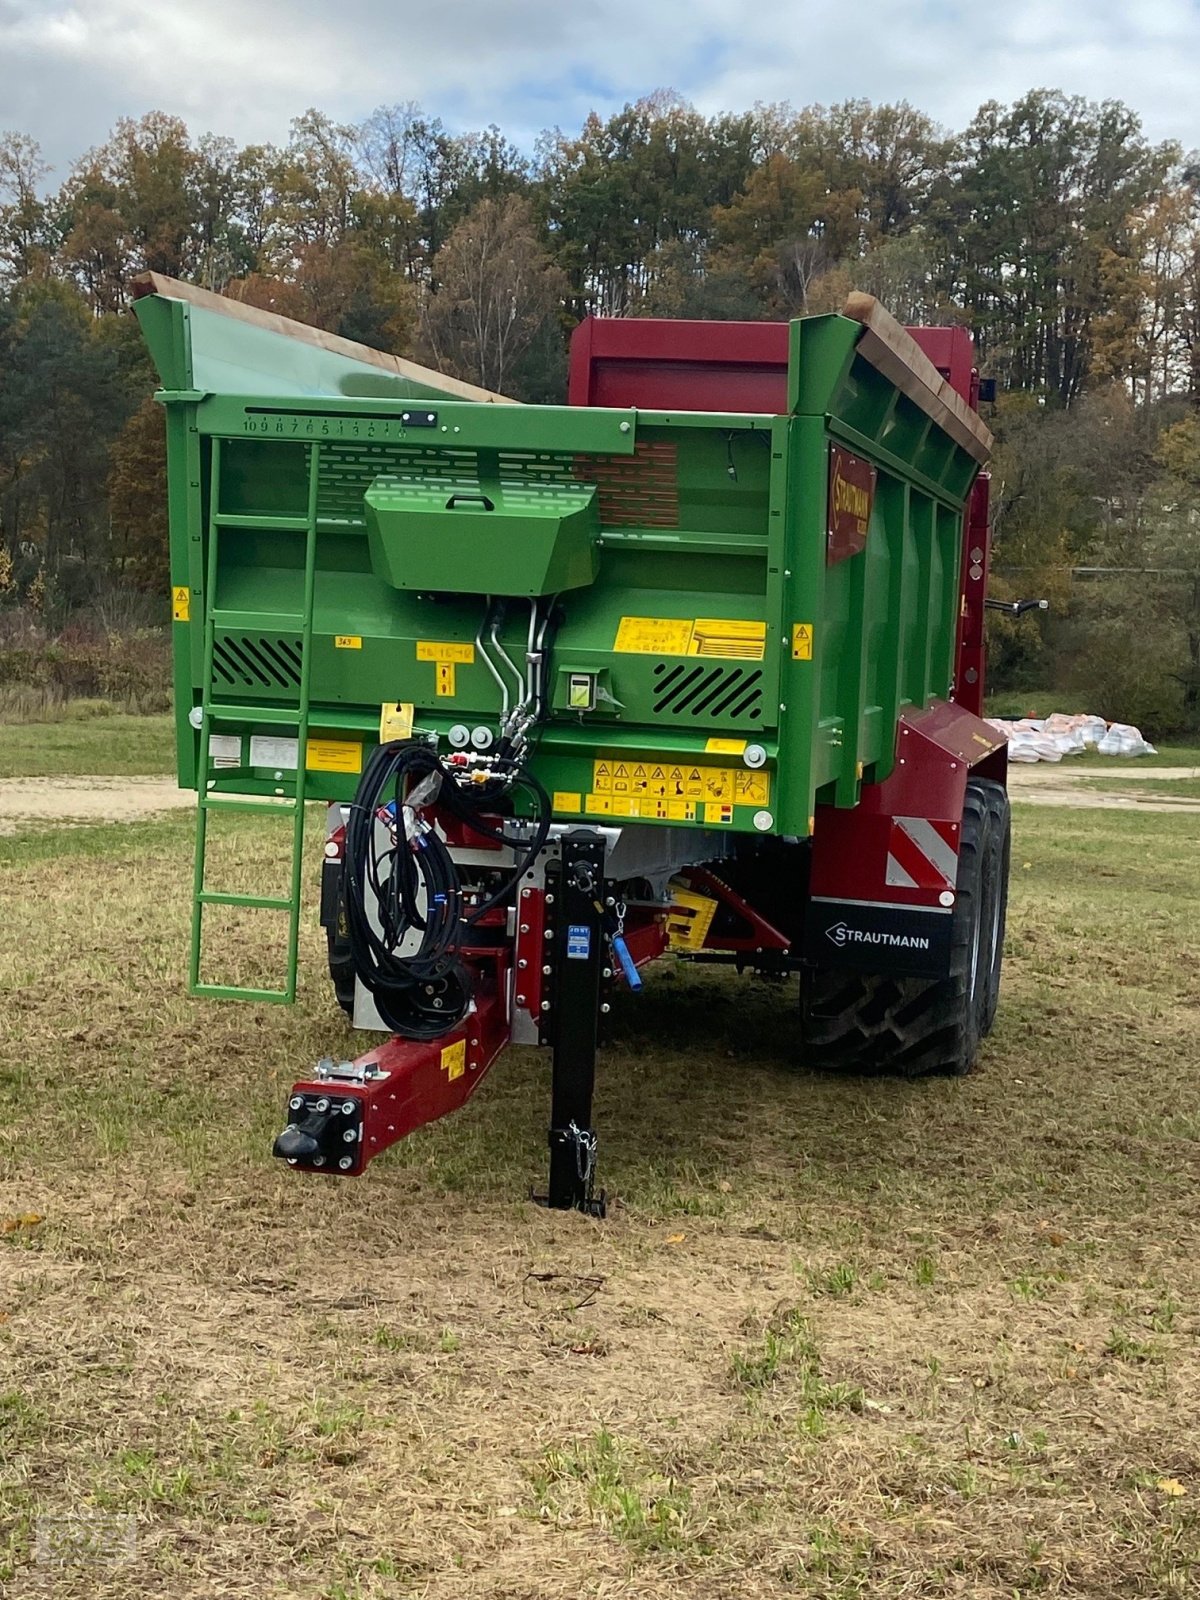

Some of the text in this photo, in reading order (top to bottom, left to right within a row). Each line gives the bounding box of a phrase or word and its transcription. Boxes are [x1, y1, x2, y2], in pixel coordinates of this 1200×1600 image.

[243, 420, 257, 431] 10
[260, 421, 268, 432] 9
[276, 422, 283, 433] 8
[291, 423, 299, 433] 7
[306, 424, 314, 434] 6
[321, 424, 329, 435] 5
[352, 426, 360, 437] 3
[367, 427, 375, 437] 2
[835, 928, 929, 949] STRAUTMANN
